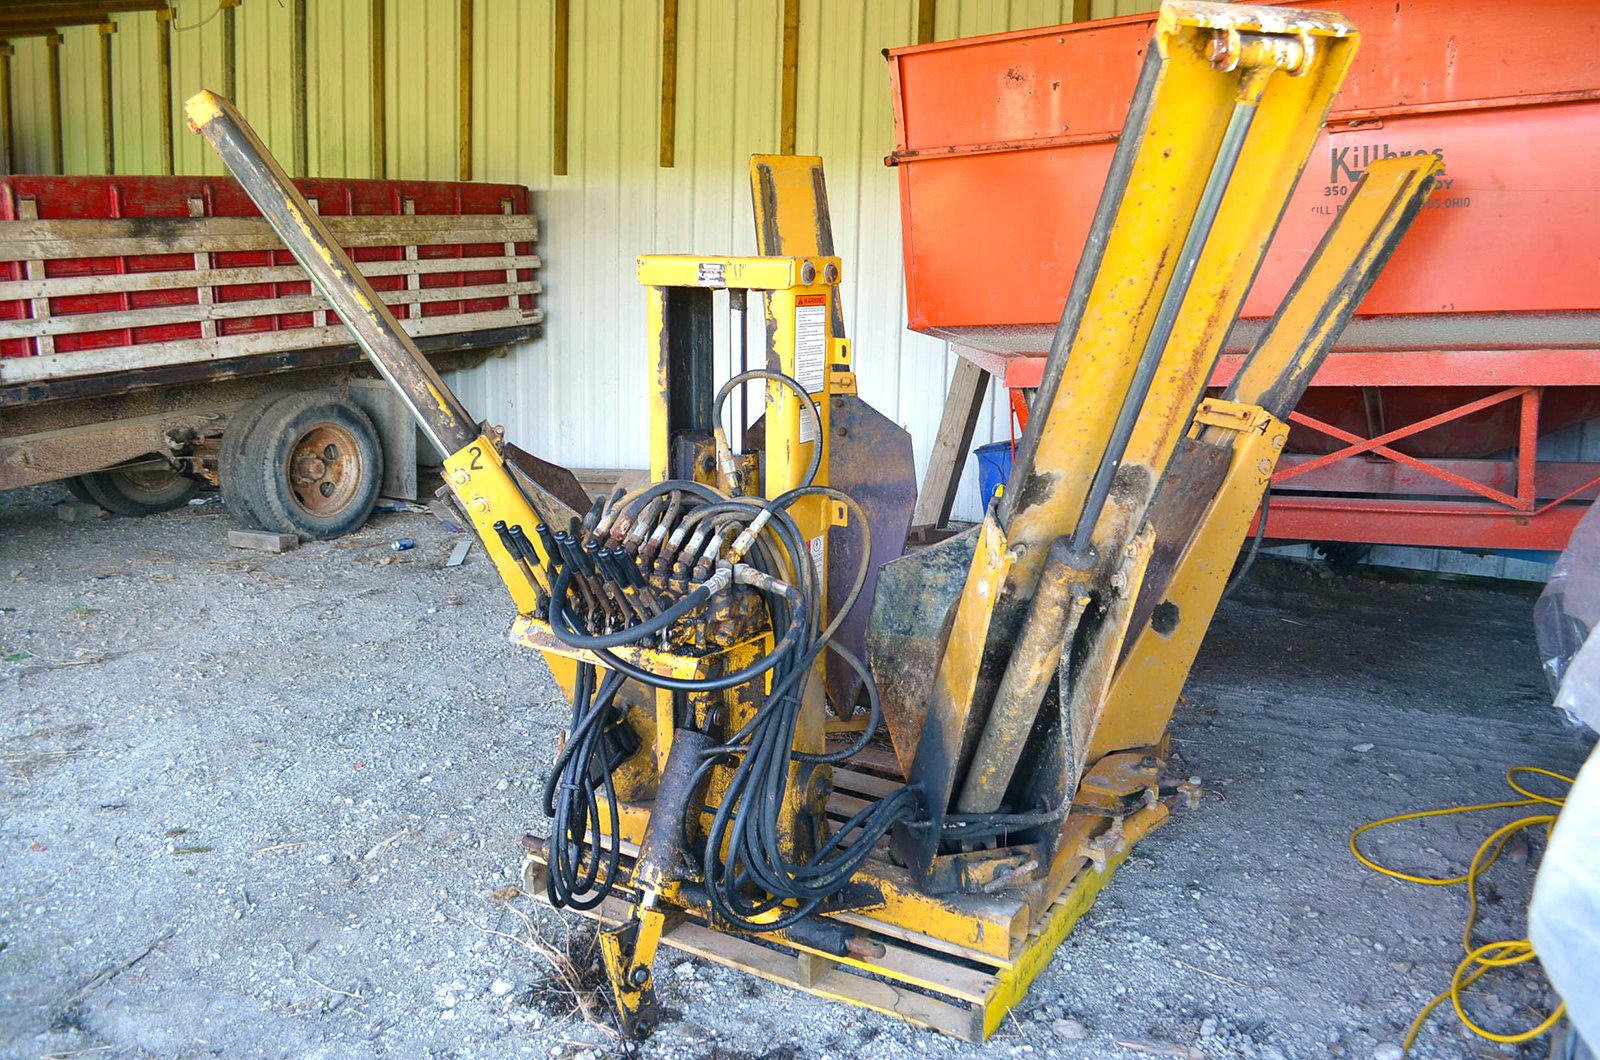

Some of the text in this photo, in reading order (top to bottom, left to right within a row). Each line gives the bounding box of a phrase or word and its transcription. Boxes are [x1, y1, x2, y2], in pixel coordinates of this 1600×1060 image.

[1324, 185, 1347, 197] 350
[1445, 197, 1470, 208] OHIO
[803, 296, 825, 304] WARNING
[1257, 418, 1271, 436] 4
[469, 446, 483, 470] 2
